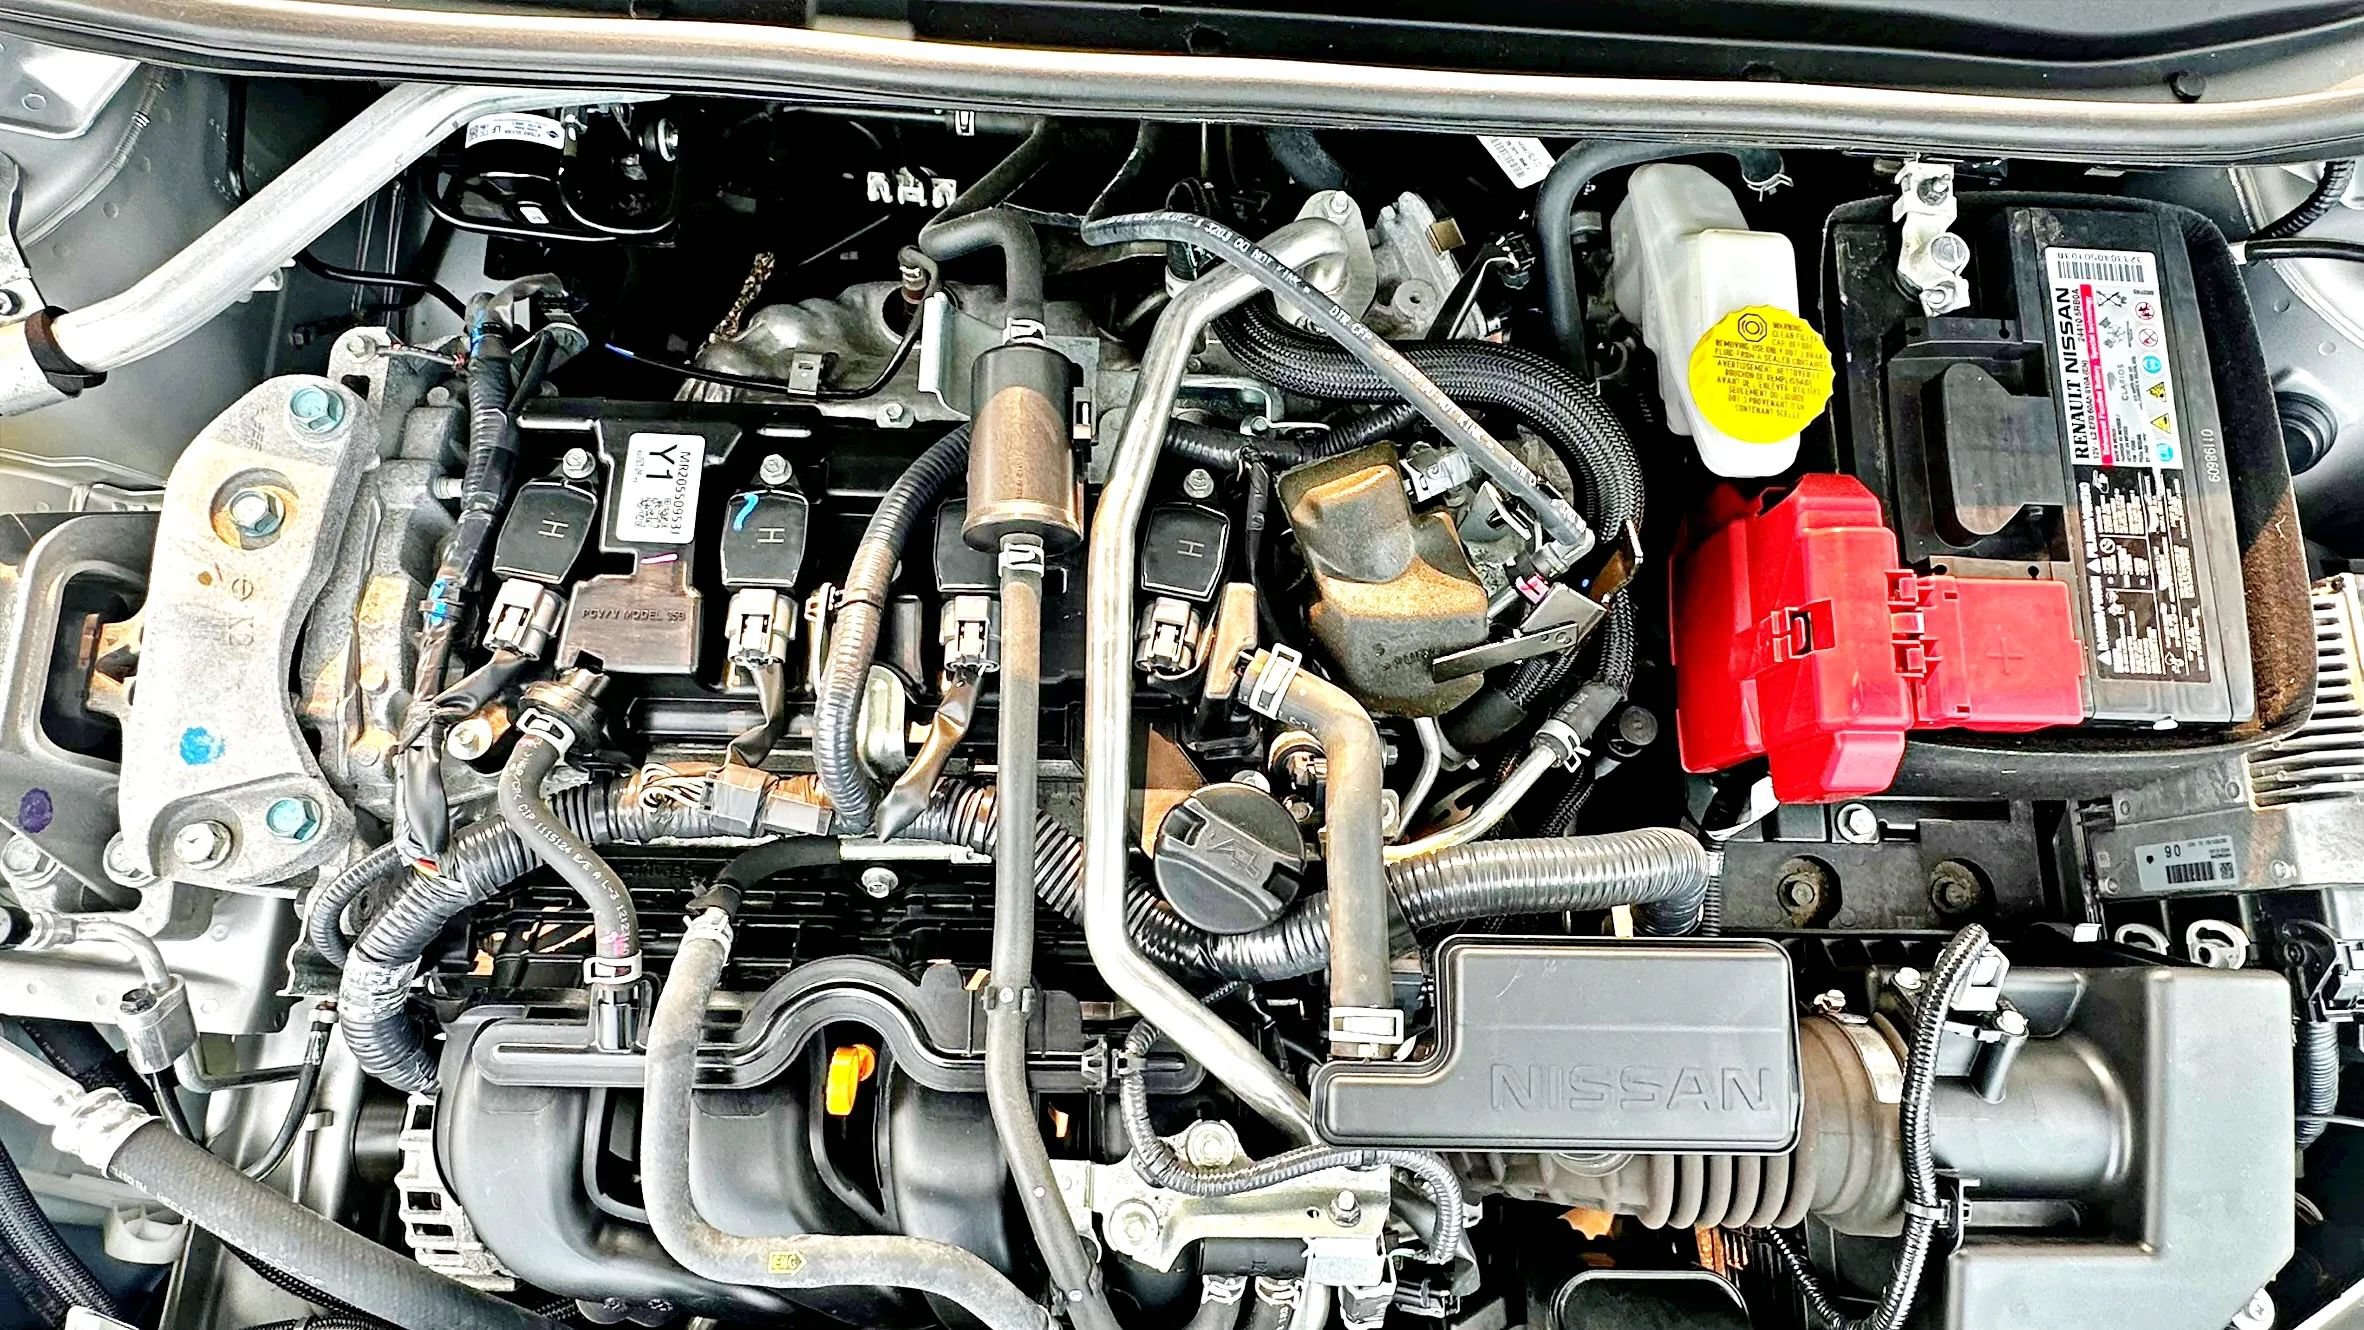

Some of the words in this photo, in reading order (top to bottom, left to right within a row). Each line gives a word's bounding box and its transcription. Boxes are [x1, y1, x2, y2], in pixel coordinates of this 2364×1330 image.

[2055, 287, 2079, 374] NISSAN
[2066, 379, 2090, 459] RENAULT
[646, 444, 678, 480] Y1
[623, 608, 664, 621] MODEL
[1490, 1062, 1773, 1112] NISSAN
